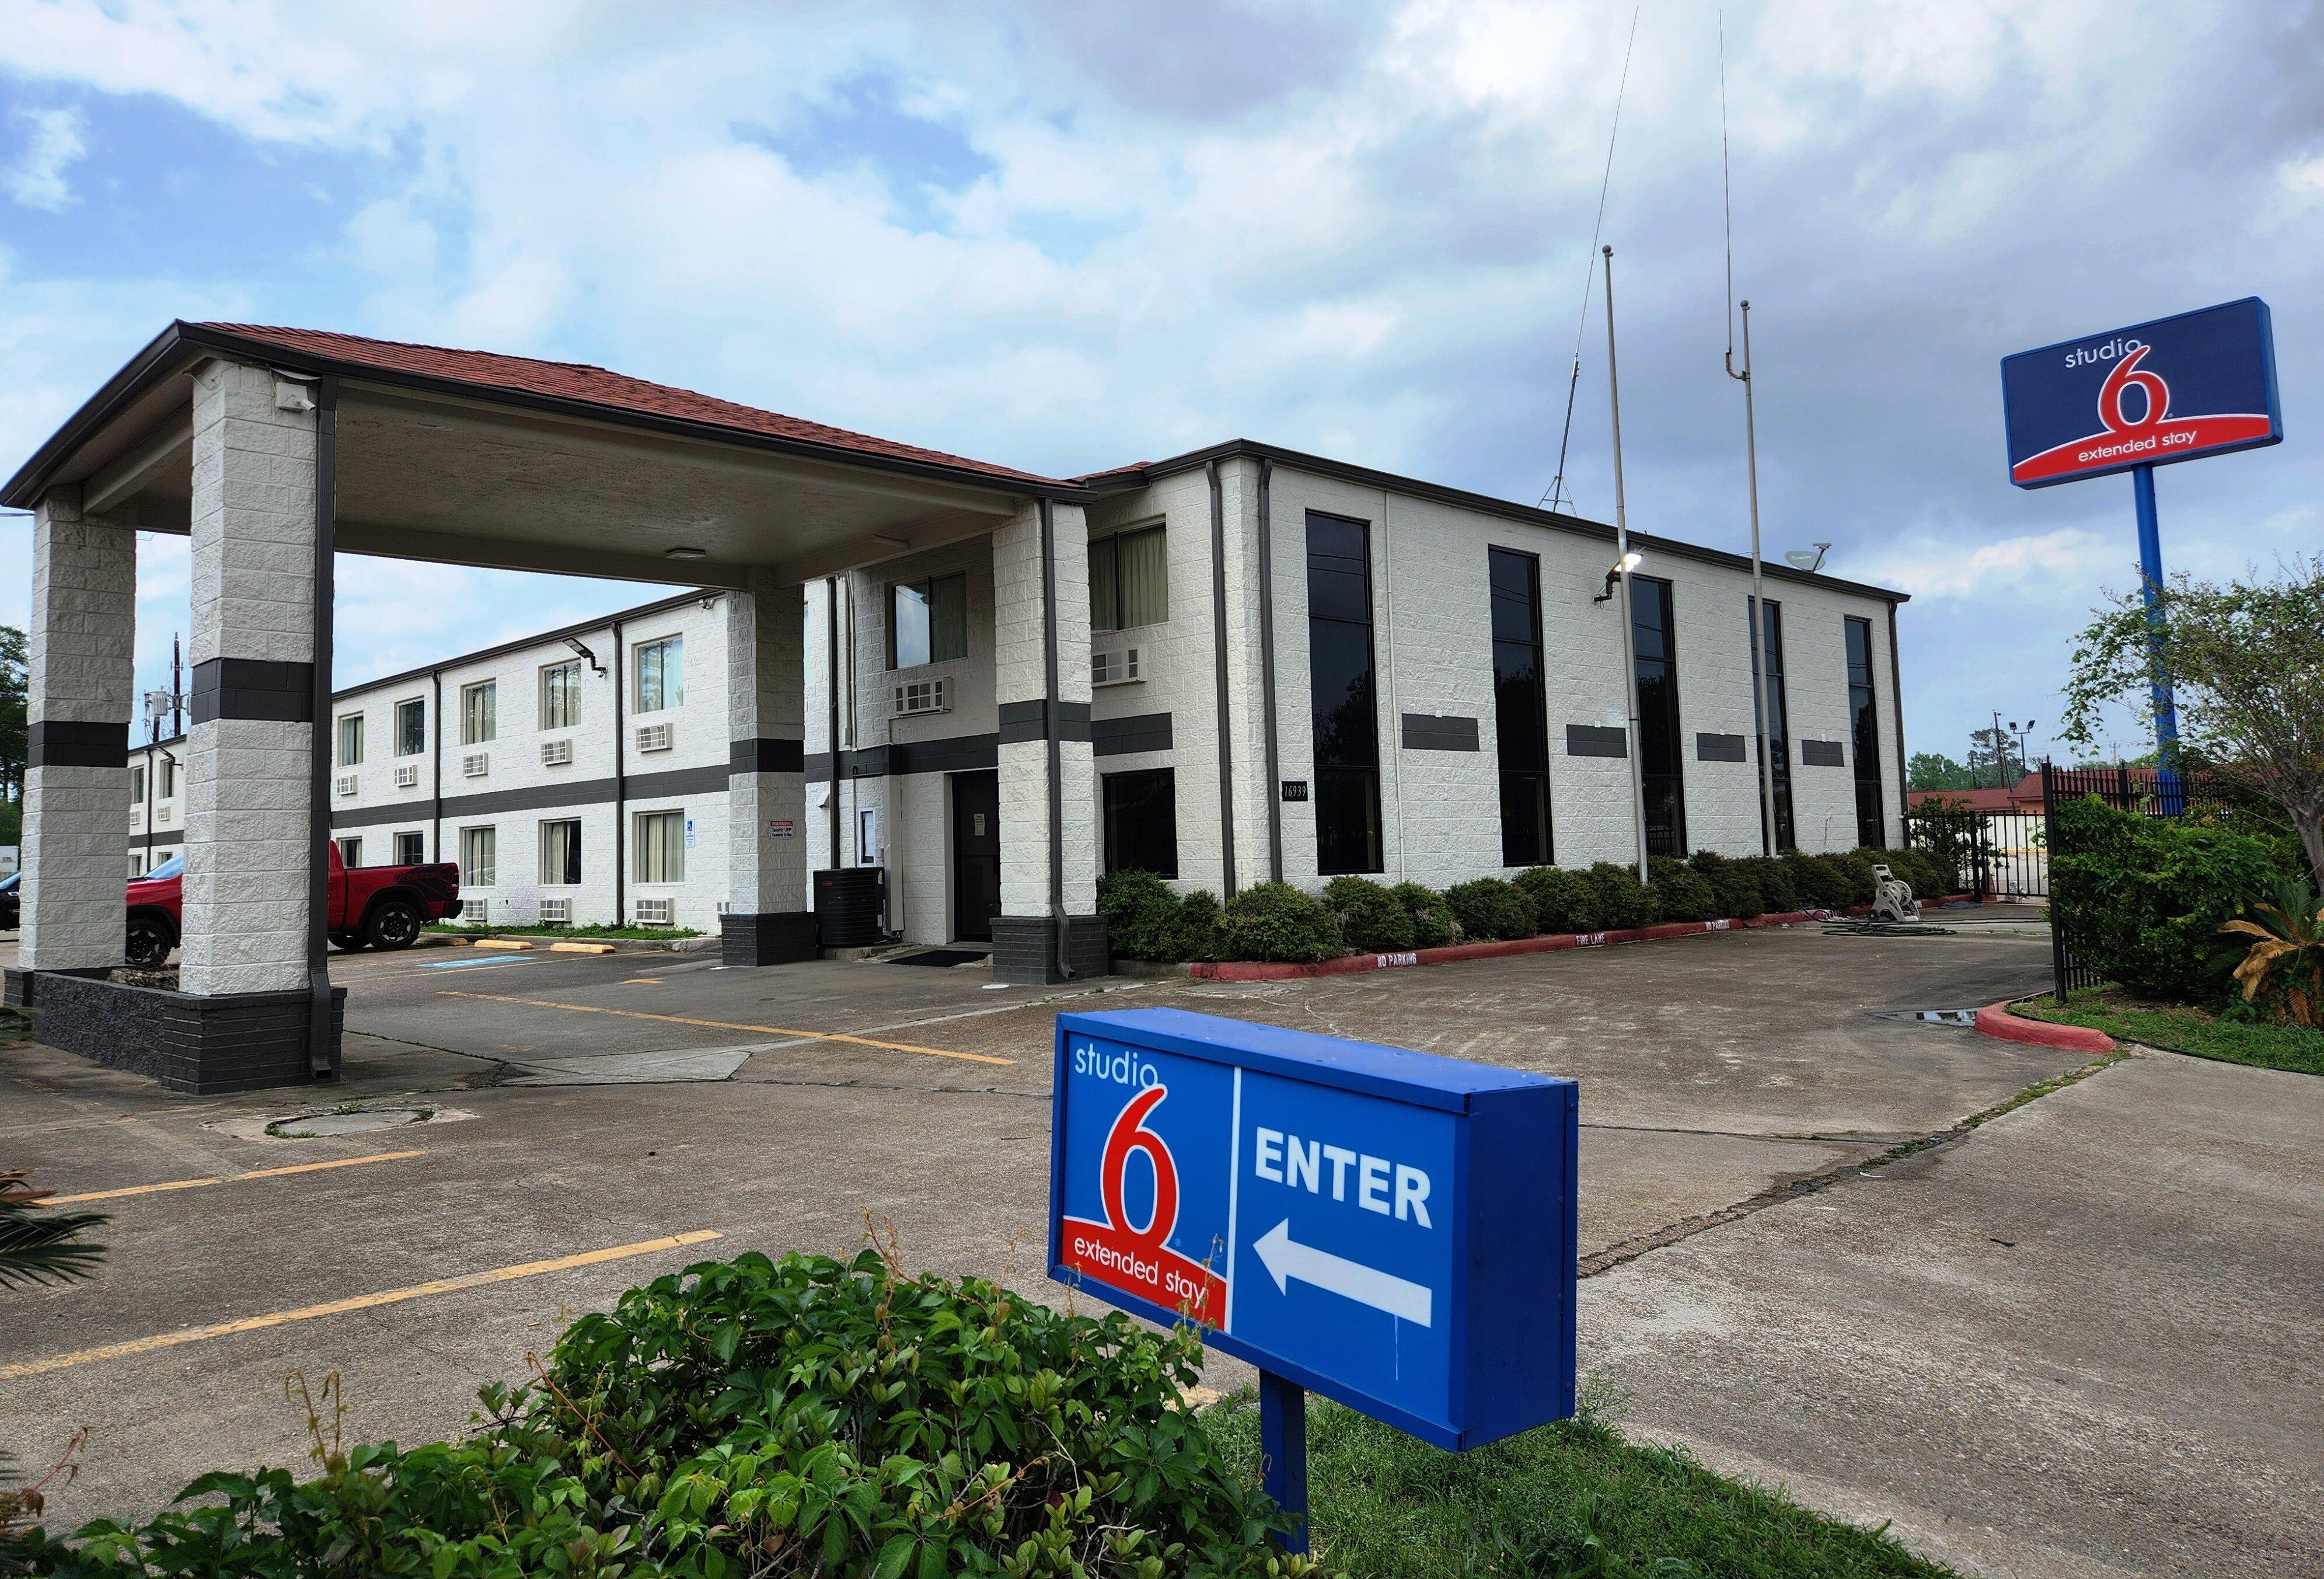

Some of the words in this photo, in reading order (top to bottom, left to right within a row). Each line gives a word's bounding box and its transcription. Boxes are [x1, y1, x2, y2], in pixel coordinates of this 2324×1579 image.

[2065, 338, 2141, 368] studio
[2098, 344, 2169, 433] 6
[2078, 435, 2156, 462] extended
[2162, 431, 2197, 446] stay
[1285, 785, 1306, 797] 16939
[1576, 935, 1589, 946] FIRE
[1590, 933, 1605, 944] LANE
[1377, 955, 1387, 968] NO
[1388, 953, 1417, 966] PARKING
[1074, 1043, 1158, 1089] studio
[1100, 1083, 1180, 1247] 6
[1255, 1126, 1433, 1229] ENTER
[1074, 1237, 1158, 1285] extended
[1165, 1270, 1207, 1309] stay
